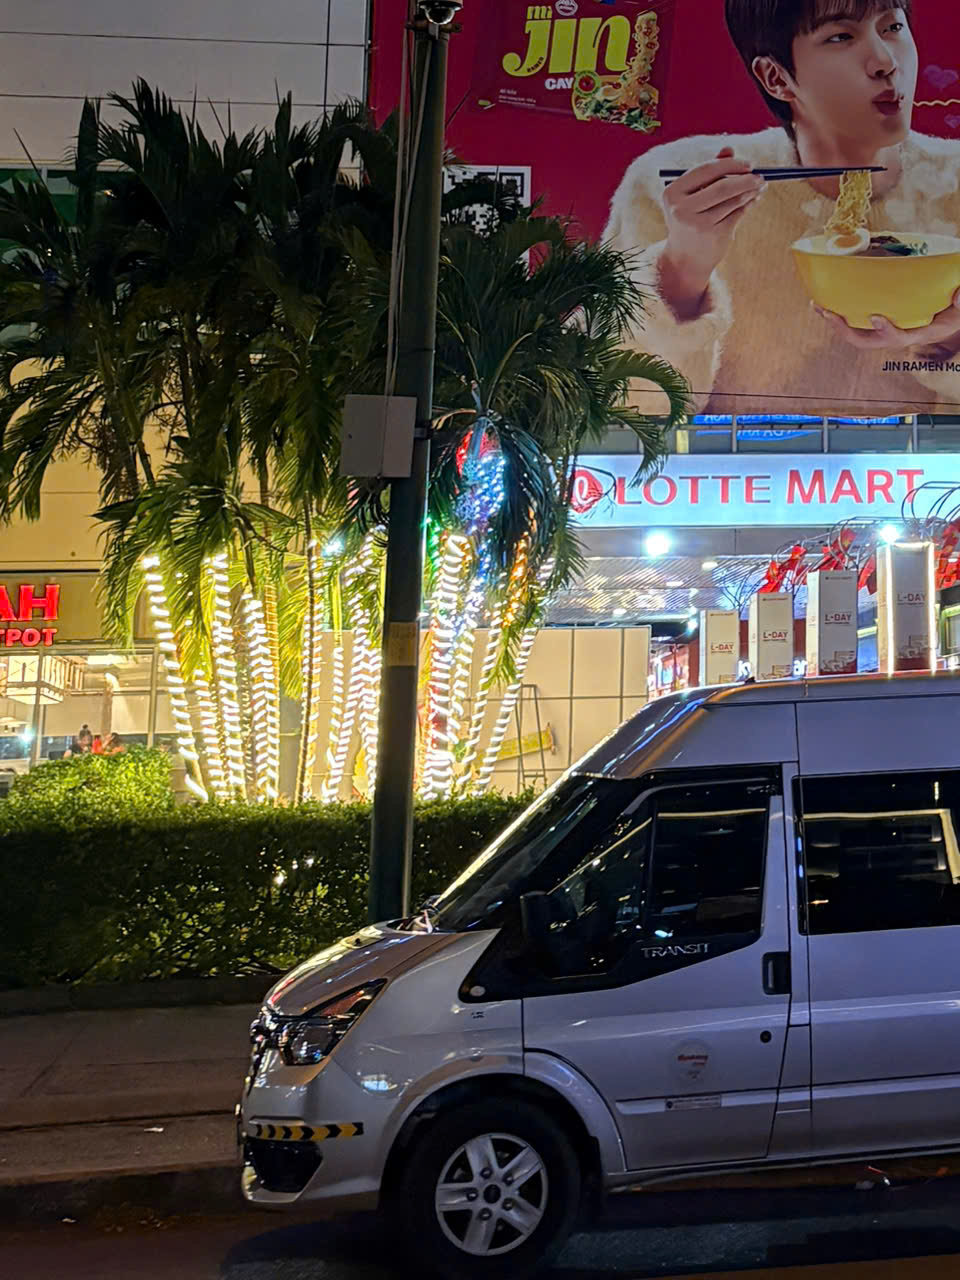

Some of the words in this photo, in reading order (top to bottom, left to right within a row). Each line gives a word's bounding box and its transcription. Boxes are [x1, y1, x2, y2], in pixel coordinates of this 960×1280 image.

[544, 77, 574, 90] CAY
[882, 360, 901, 371] JIN
[903, 361, 943, 372] RAMEN
[617, 475, 771, 505] LOTTE
[786, 468, 925, 505] MART
[640, 943, 711, 959] TRANSIT
